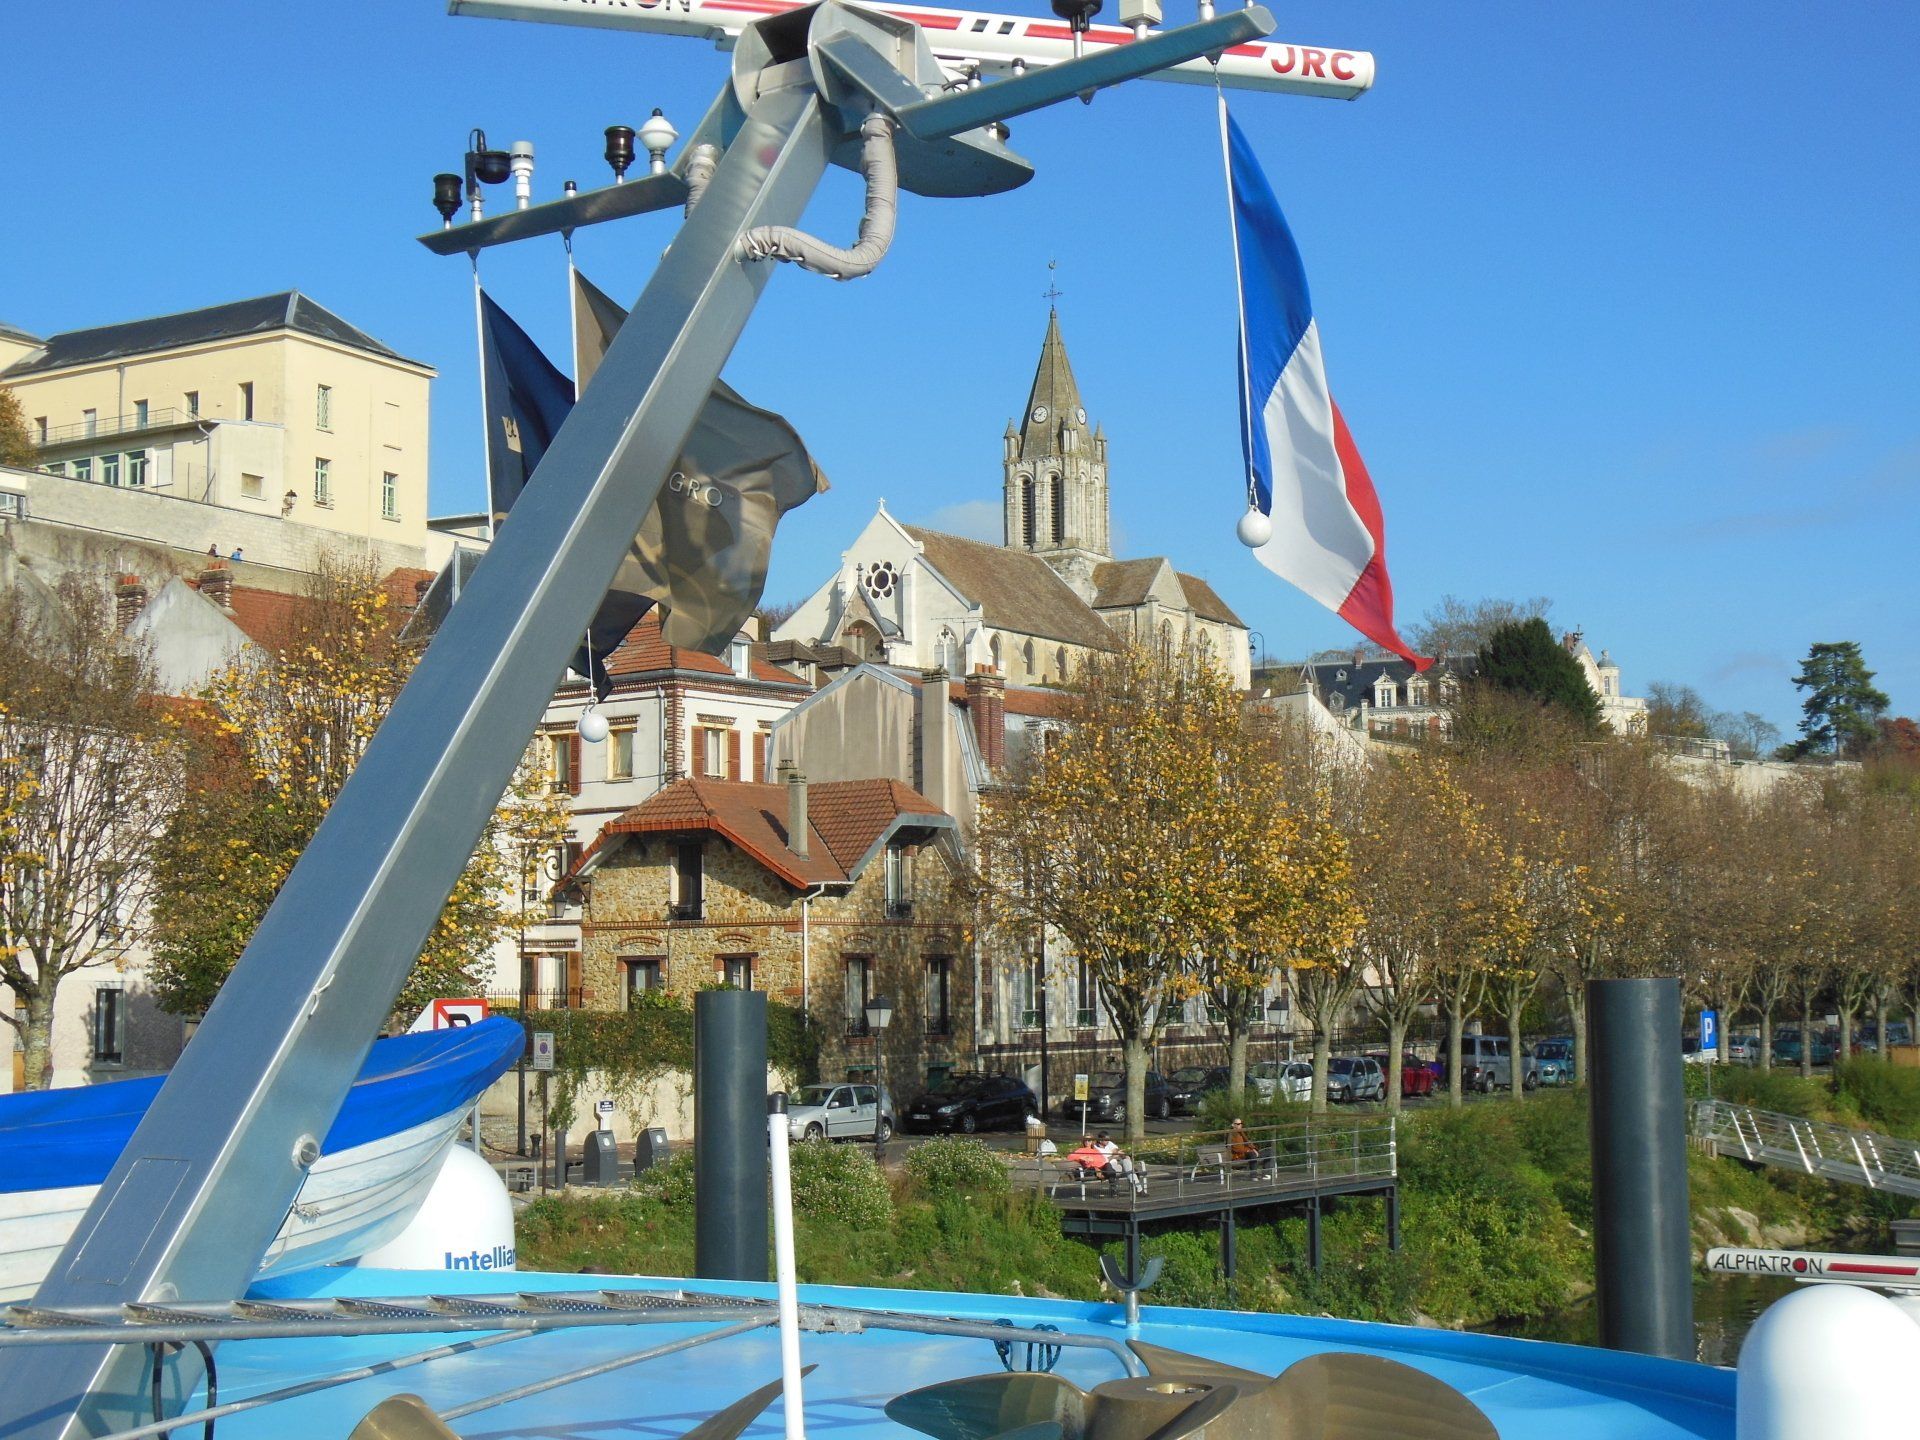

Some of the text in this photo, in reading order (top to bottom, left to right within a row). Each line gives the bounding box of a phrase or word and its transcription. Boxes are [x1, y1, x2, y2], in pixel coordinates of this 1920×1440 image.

[1270, 46, 1356, 81] JRC
[1704, 1017, 1713, 1043] P
[1713, 1253, 1824, 1275] ALPHATRON
